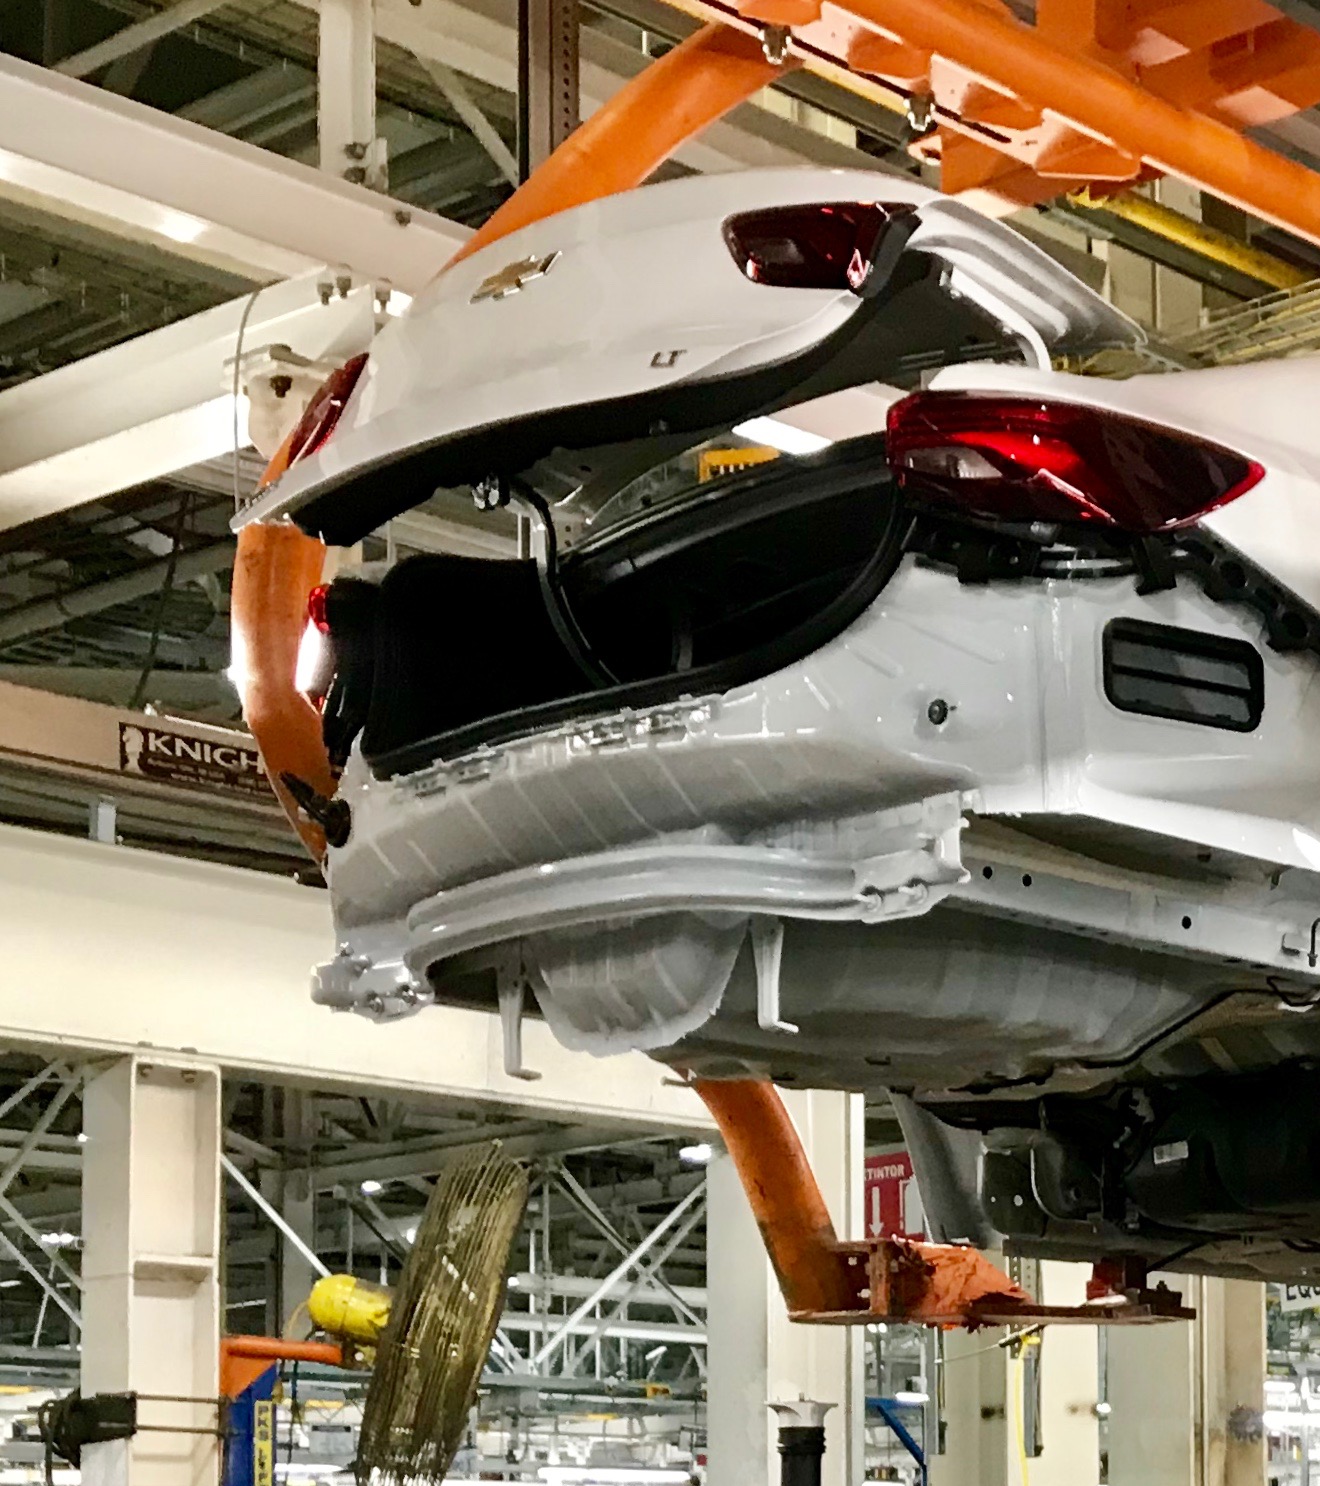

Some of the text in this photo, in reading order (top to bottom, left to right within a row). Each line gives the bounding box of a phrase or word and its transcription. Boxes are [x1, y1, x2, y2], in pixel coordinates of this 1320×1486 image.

[650, 349, 687, 368] LT
[148, 732, 268, 774] KNIGH
[864, 1164, 905, 1180] TINTOR
